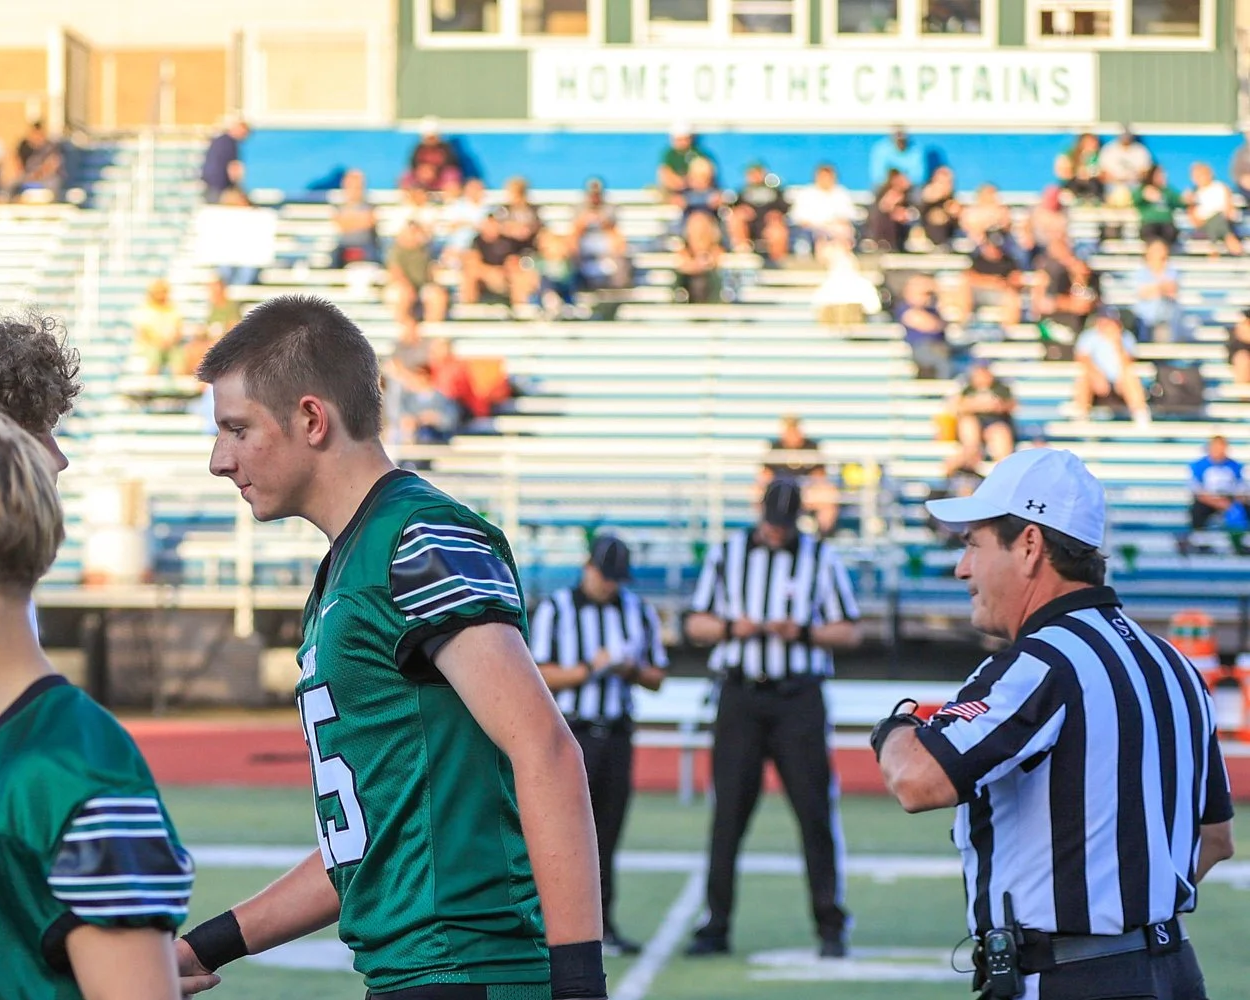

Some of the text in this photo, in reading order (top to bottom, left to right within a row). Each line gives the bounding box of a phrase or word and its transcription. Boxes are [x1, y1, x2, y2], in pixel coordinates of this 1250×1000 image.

[556, 64, 1072, 106] HOME OF THE CAPTAINS
[297, 680, 369, 869] 5
